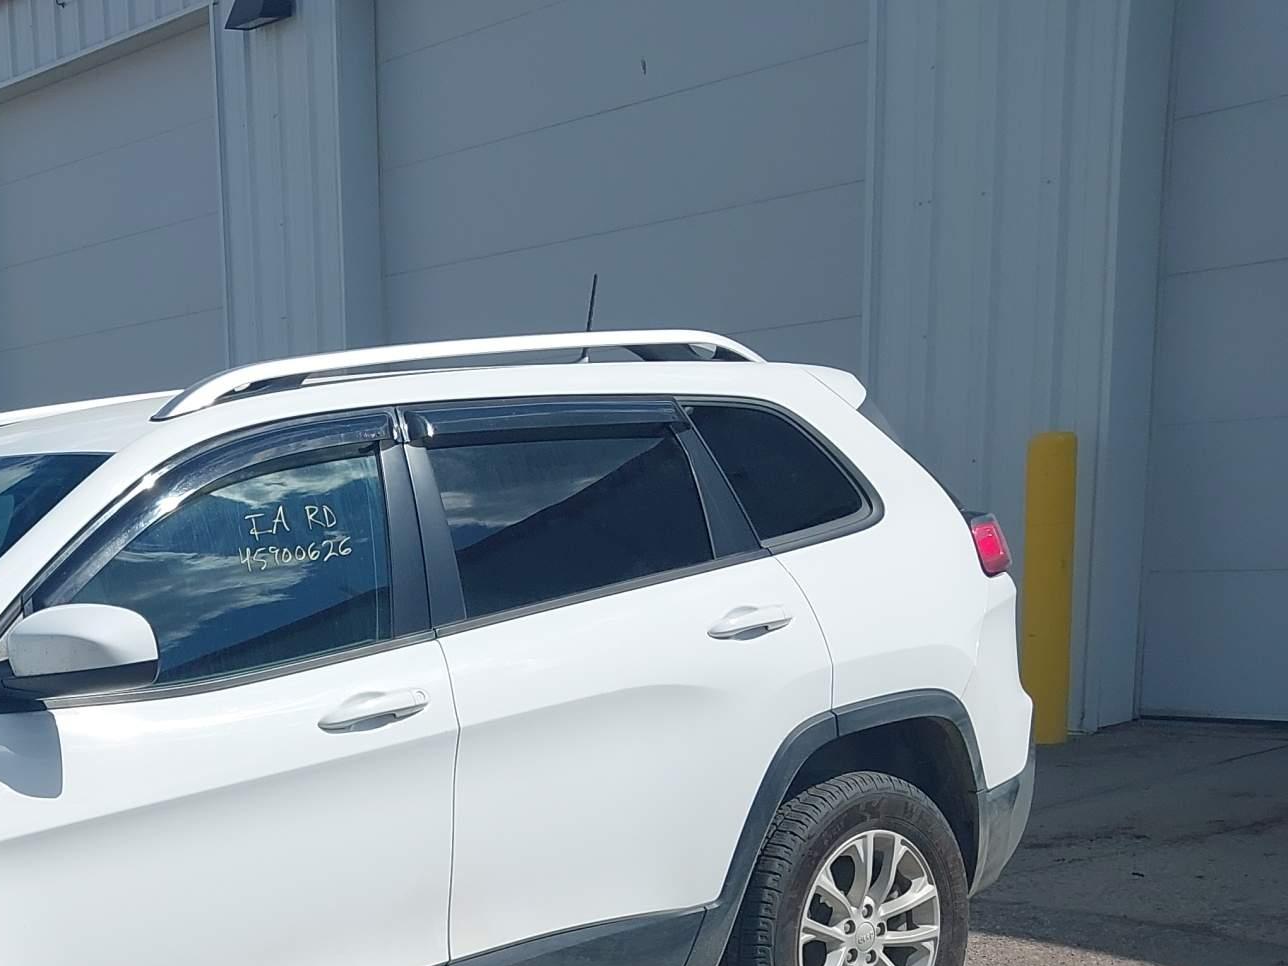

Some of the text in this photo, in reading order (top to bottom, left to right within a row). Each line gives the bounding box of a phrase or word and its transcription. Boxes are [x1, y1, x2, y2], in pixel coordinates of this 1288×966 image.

[245, 505, 336, 541] IA RD
[239, 536, 352, 572] 45900626
